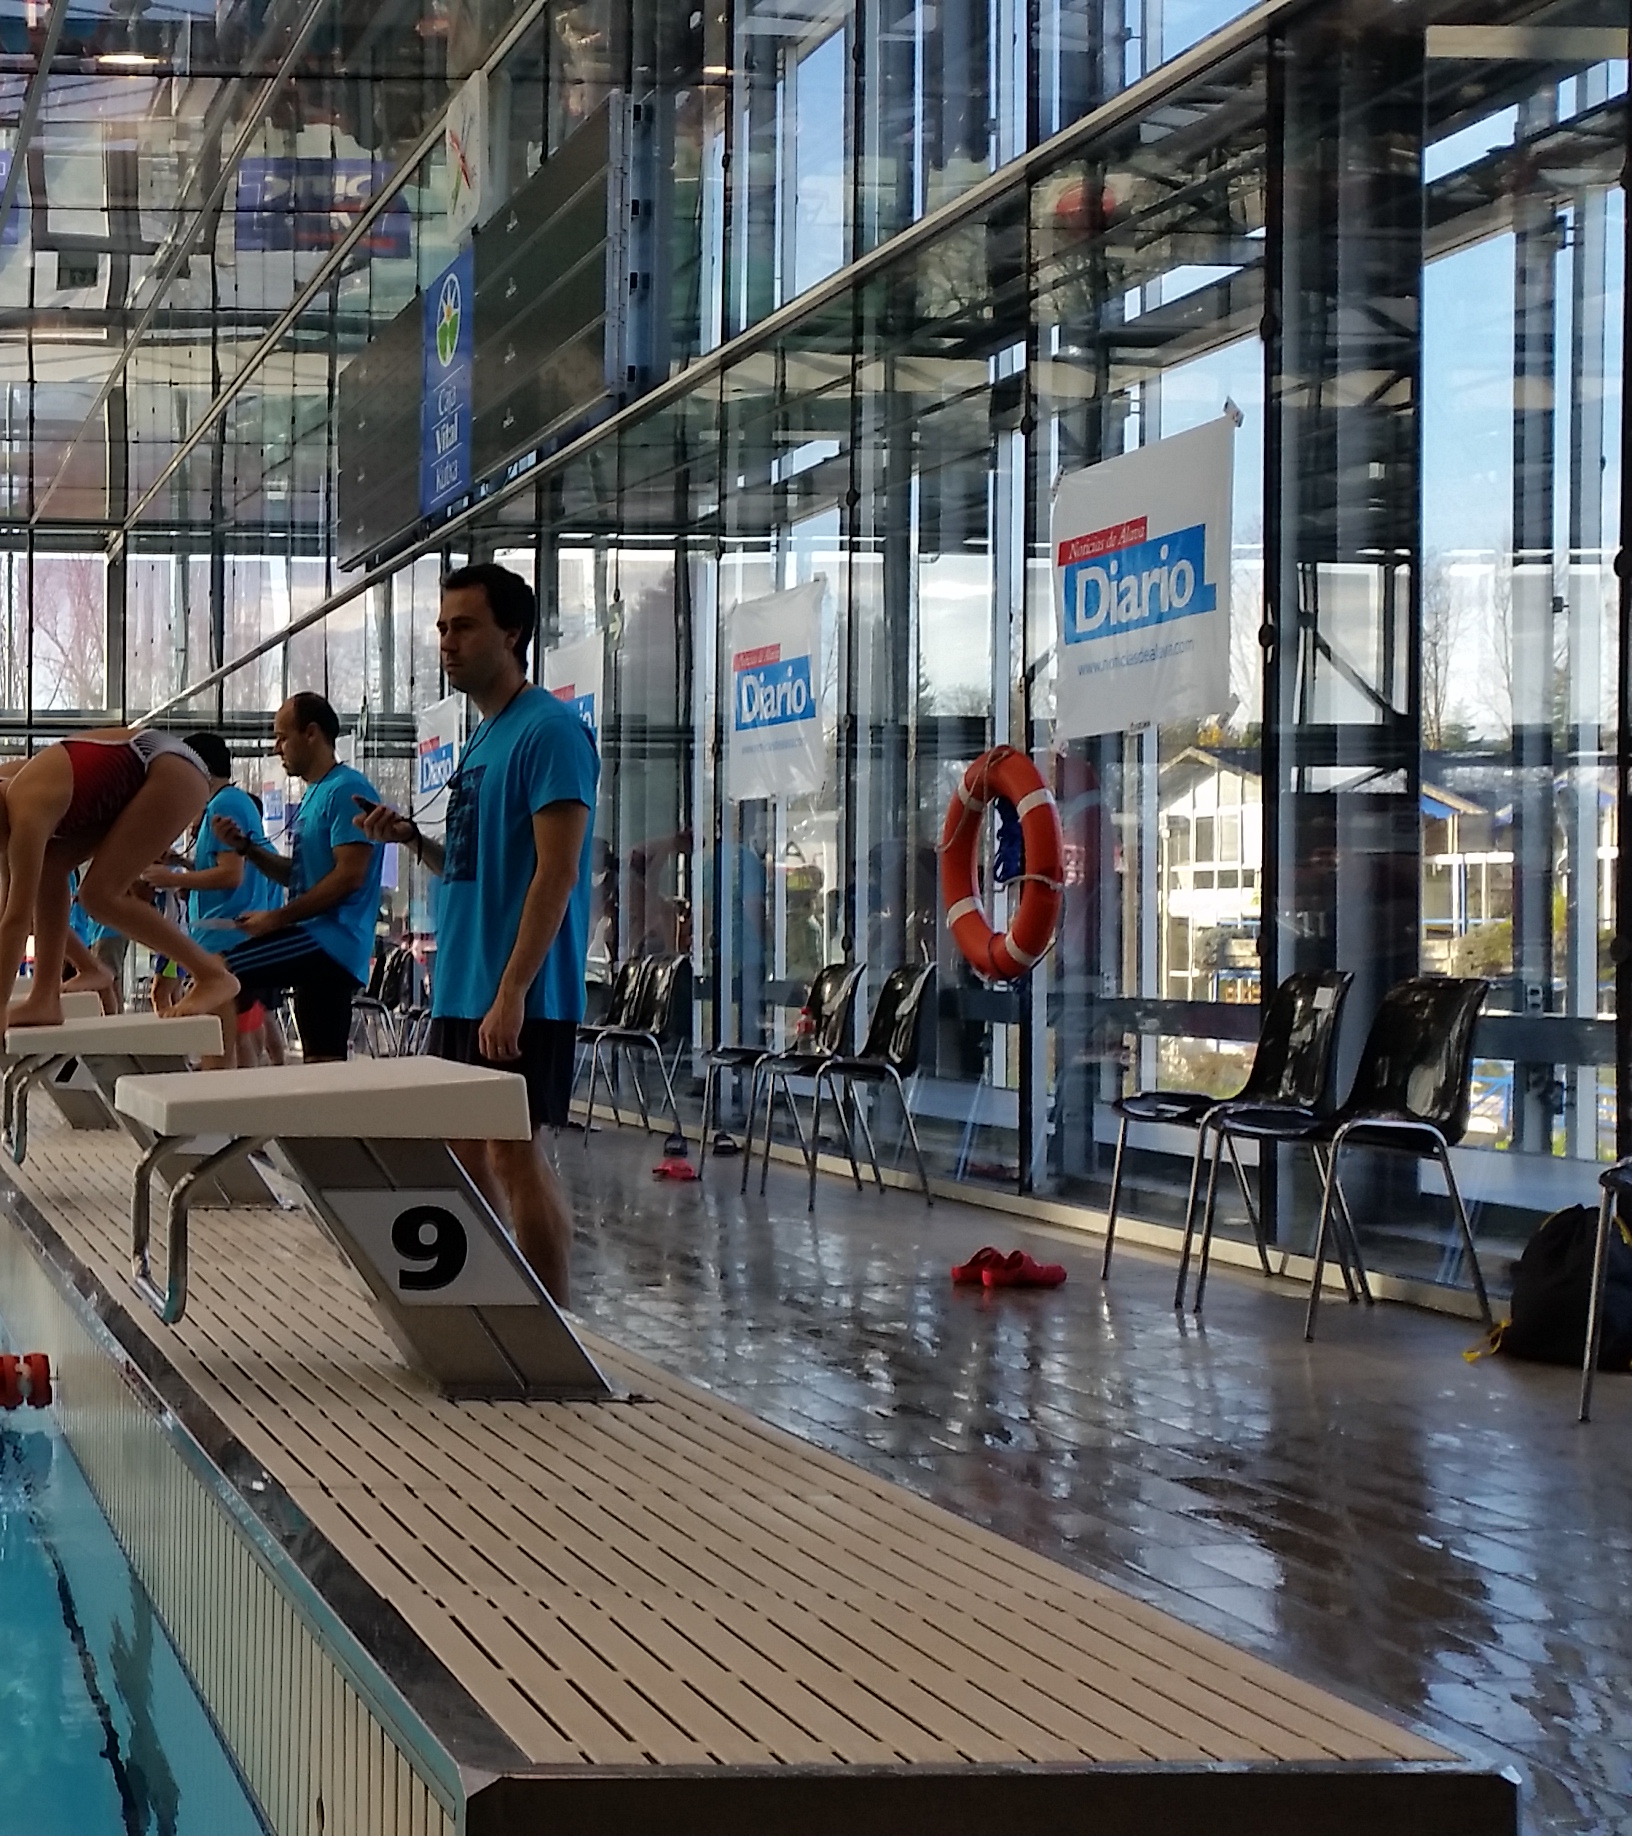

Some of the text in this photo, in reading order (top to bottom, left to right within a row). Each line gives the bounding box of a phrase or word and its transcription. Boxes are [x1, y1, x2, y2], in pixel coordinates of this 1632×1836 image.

[435, 412, 458, 455] Vital
[1106, 531, 1118, 548] de
[1075, 544, 1194, 634] Diario
[741, 665, 807, 724] Diario
[391, 1204, 468, 1291] 9
